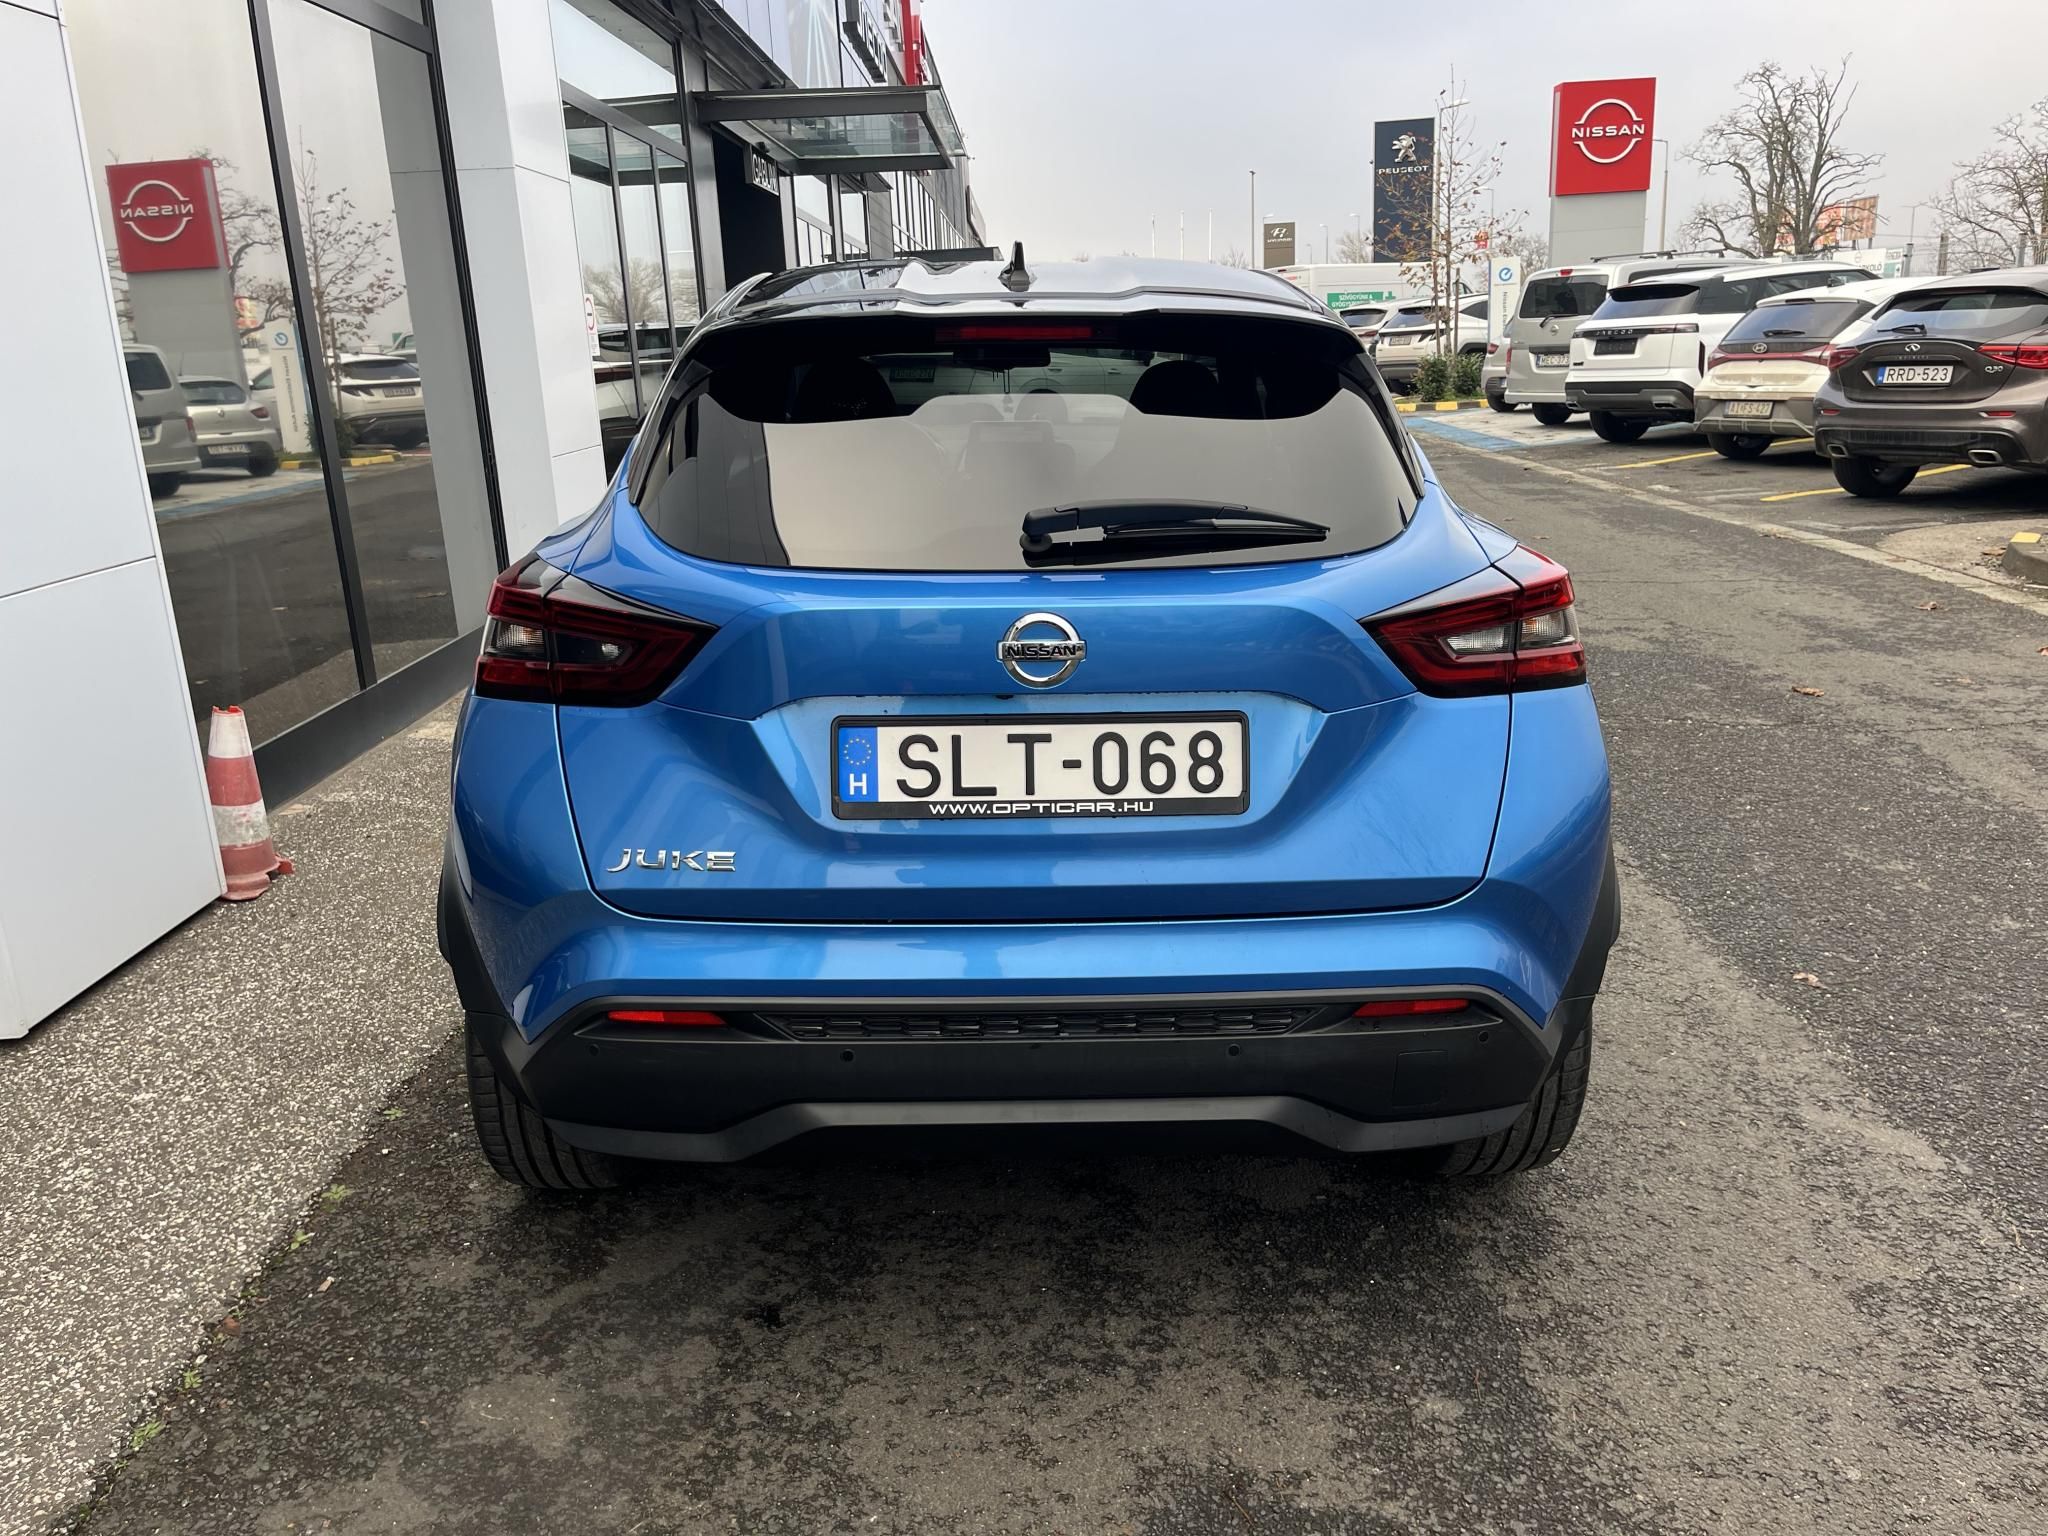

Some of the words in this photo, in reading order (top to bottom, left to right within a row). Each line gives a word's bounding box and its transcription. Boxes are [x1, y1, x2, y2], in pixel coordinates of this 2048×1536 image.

[1571, 123, 1645, 138] NISSAN
[1378, 165, 1429, 175] PEUGEOT
[1886, 367, 1949, 383] RRD-523
[1006, 645, 1077, 657] NISSAN
[896, 730, 1224, 798] SLT-068
[849, 774, 866, 796] H
[929, 801, 1154, 815] WWW.OPTICAR.HU
[606, 848, 737, 873] JUKE
